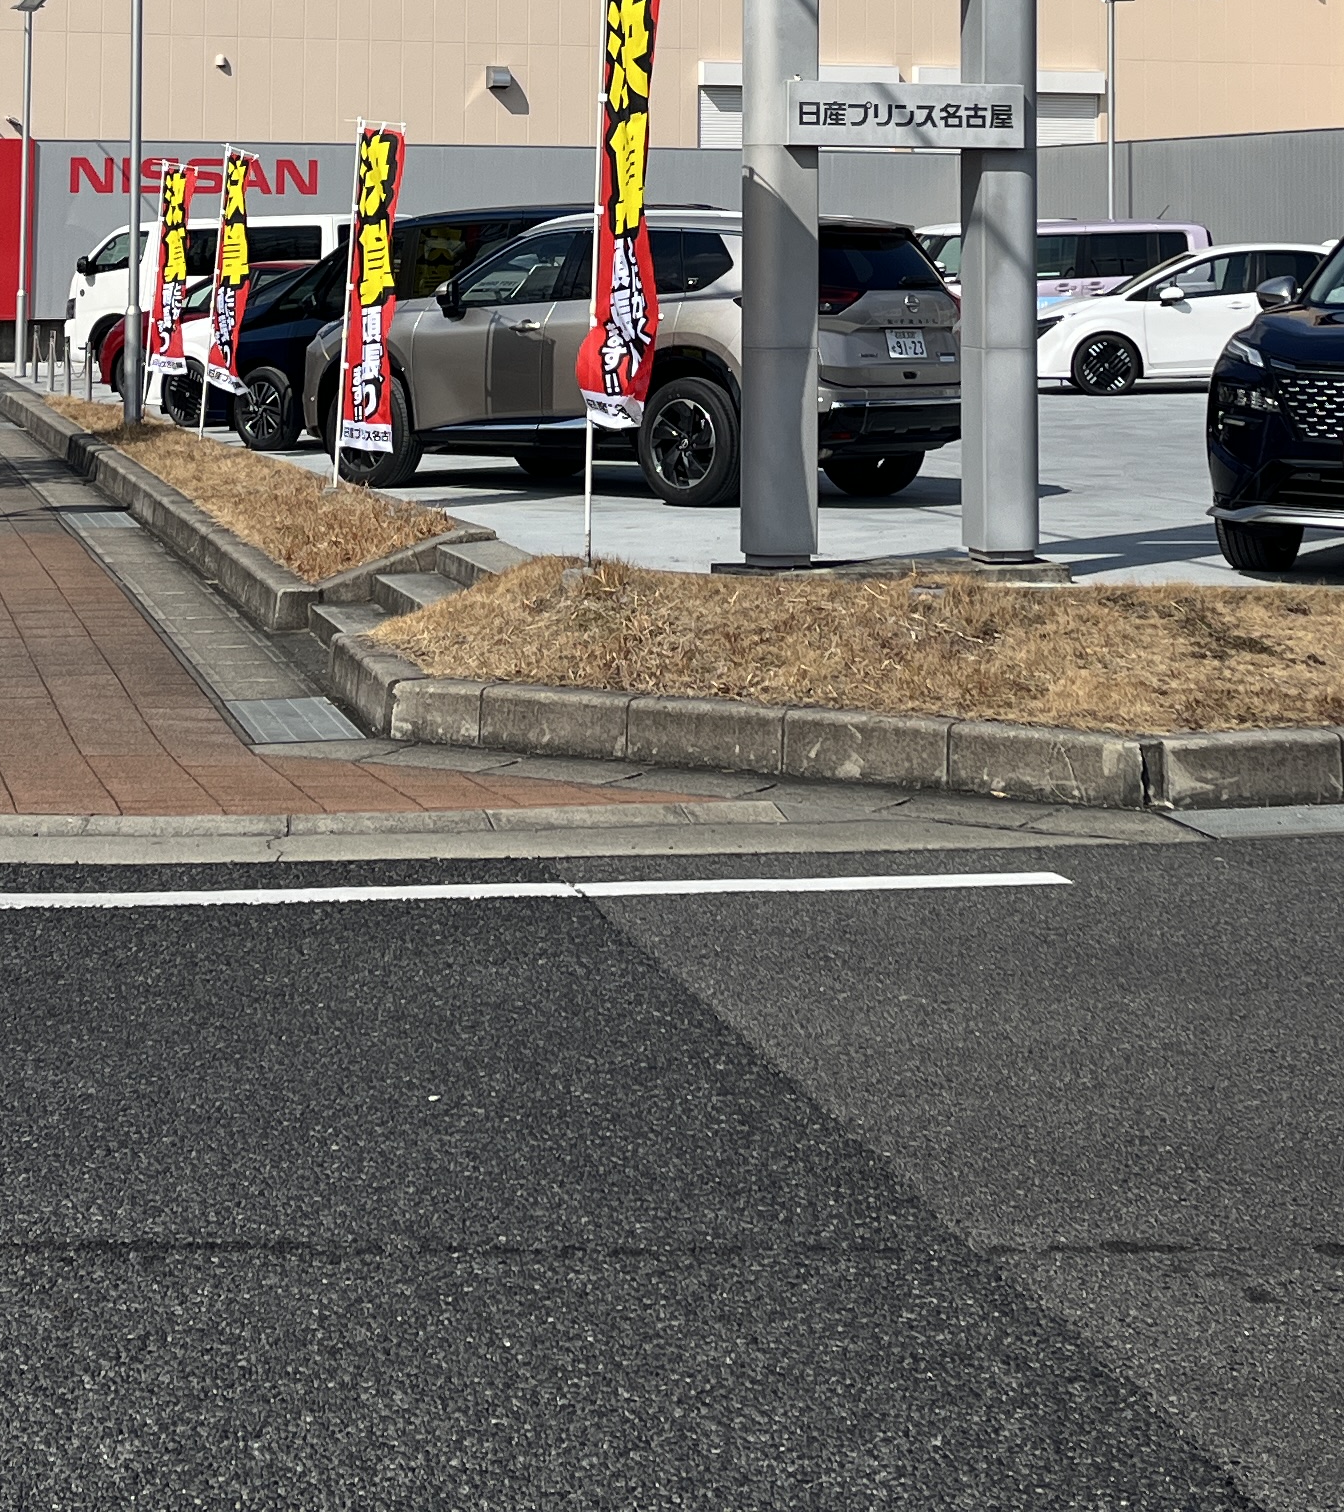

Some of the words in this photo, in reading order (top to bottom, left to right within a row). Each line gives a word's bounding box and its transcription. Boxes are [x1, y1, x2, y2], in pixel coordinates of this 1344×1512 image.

[798, 100, 1014, 129] 日産プリンス名古屋
